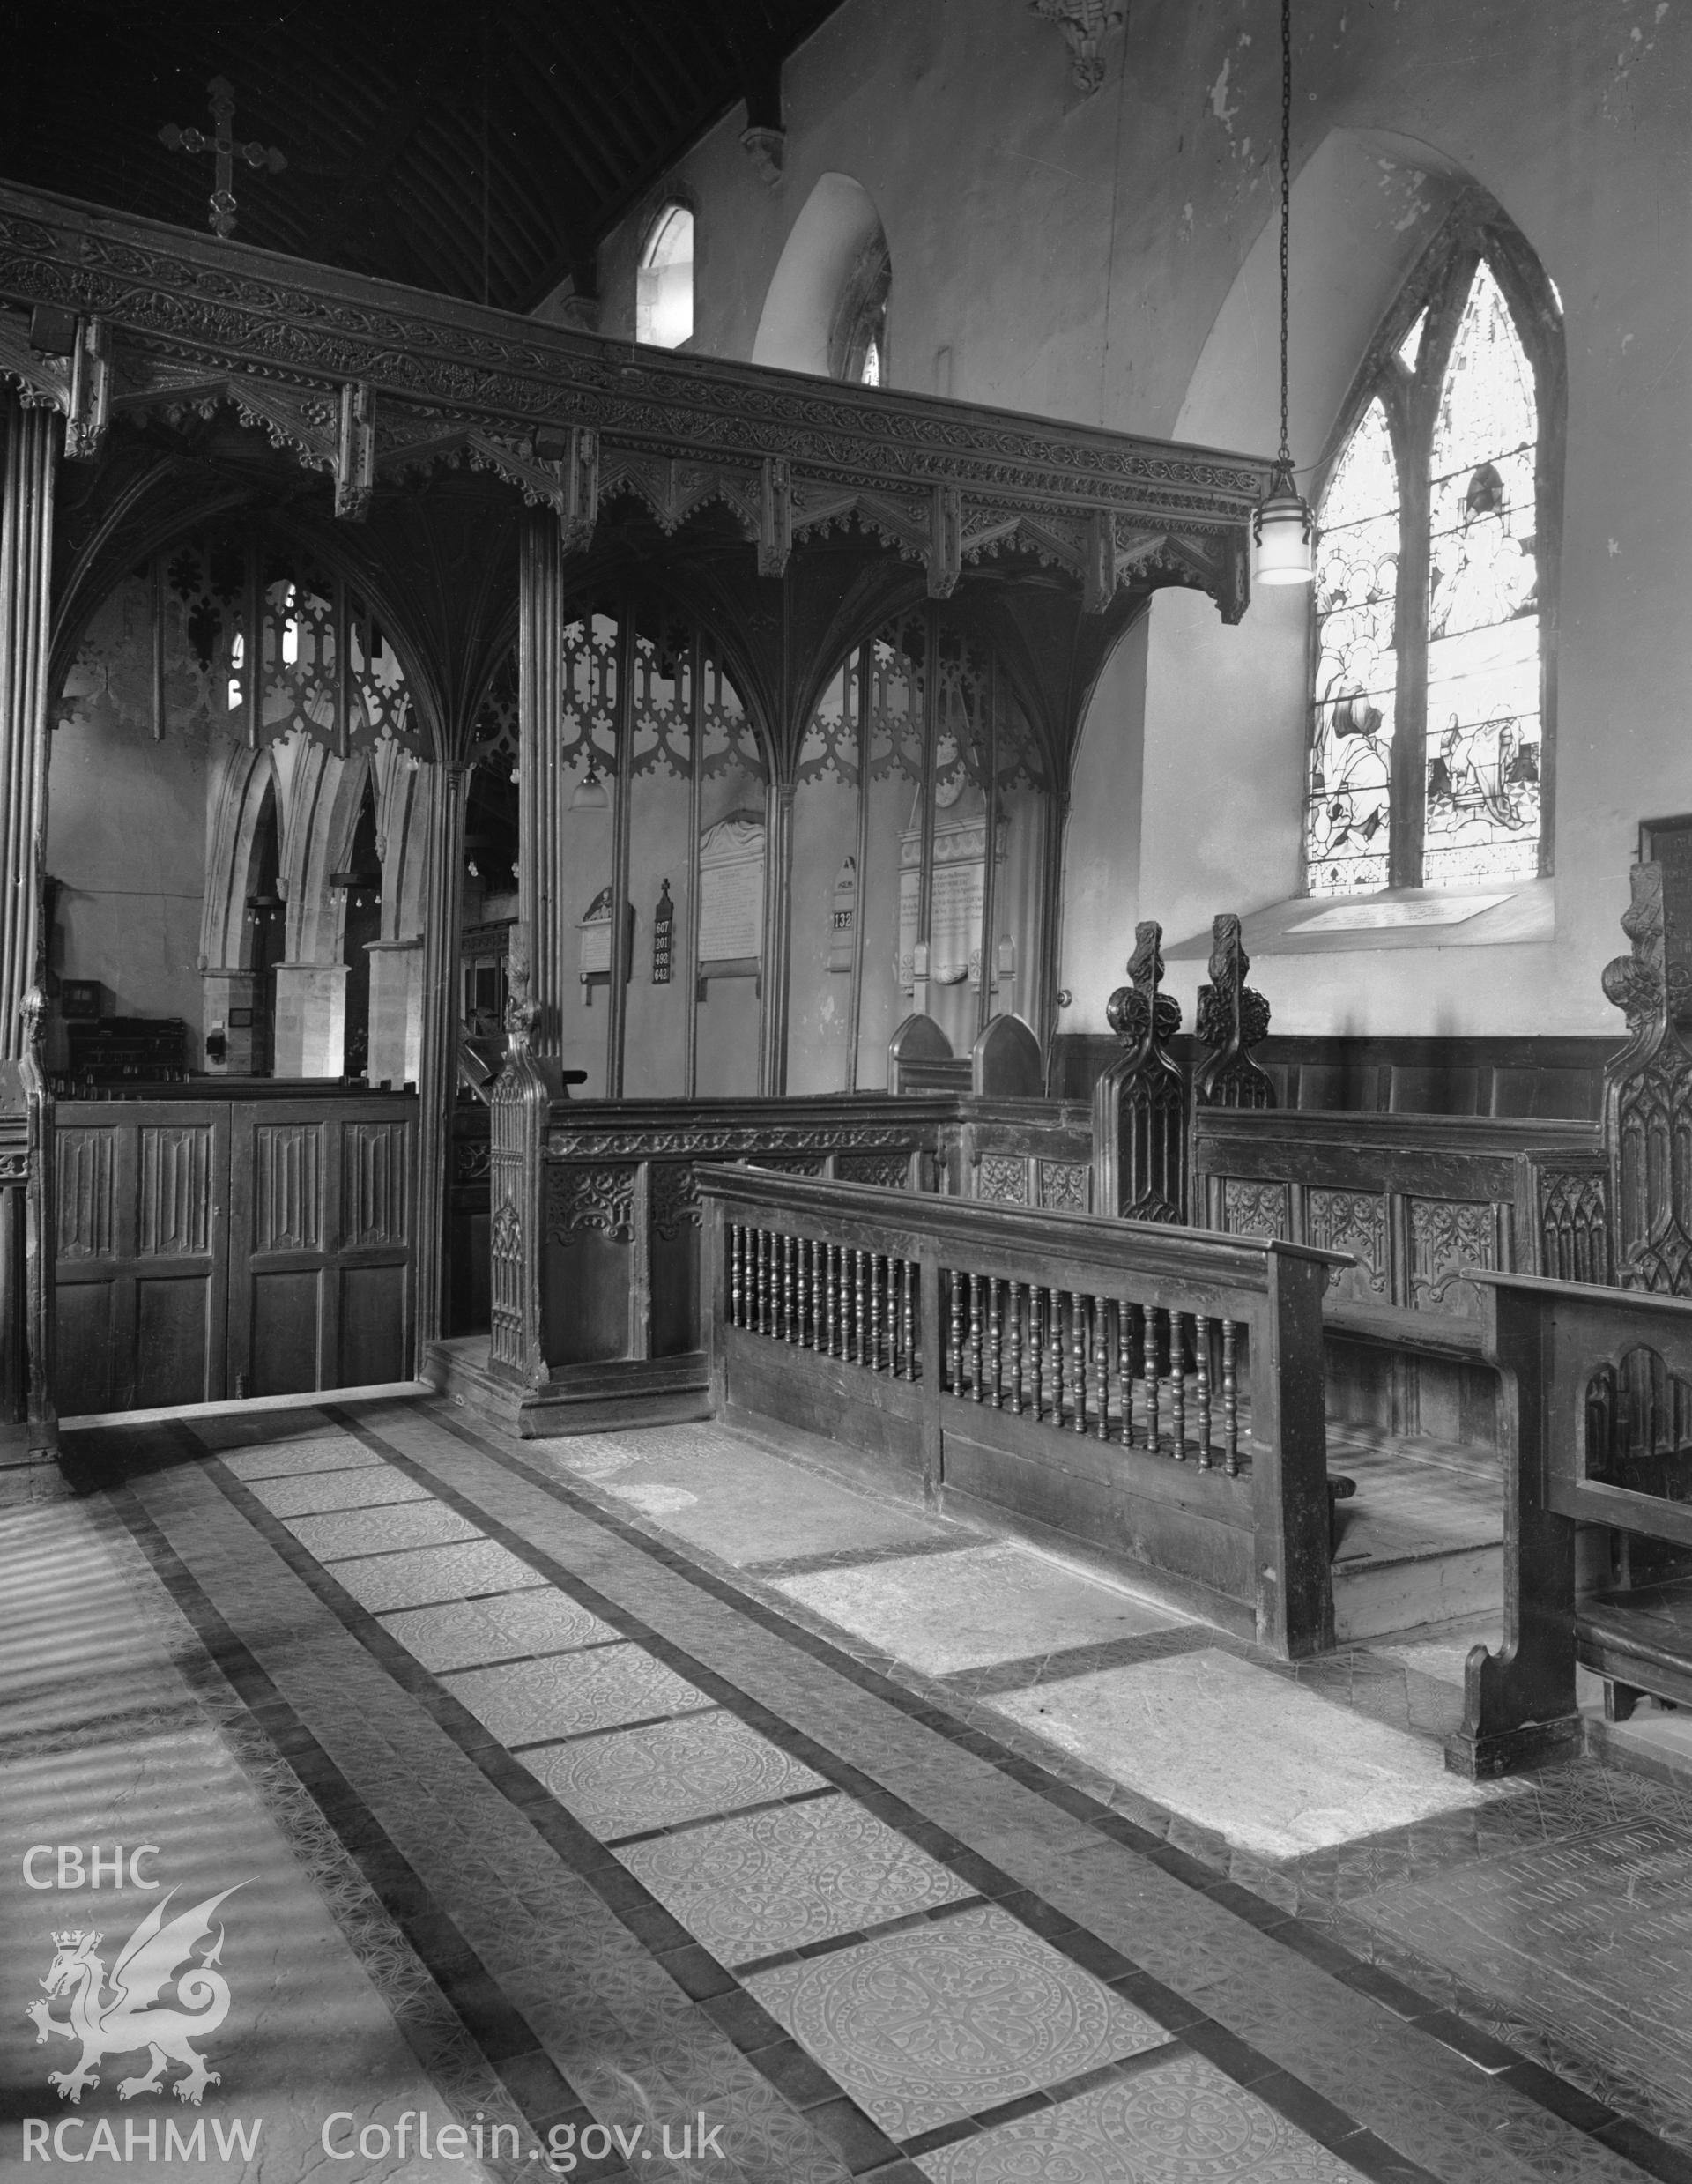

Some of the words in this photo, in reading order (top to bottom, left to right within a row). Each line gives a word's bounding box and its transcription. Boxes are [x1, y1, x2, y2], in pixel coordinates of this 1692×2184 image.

[835, 913, 852, 928] 132
[656, 921, 669, 934] 607
[656, 936, 668, 949] 201
[655, 953, 669, 965] 492
[654, 968, 668, 980] 642
[1591, 1827, 1676, 1857] BODY
